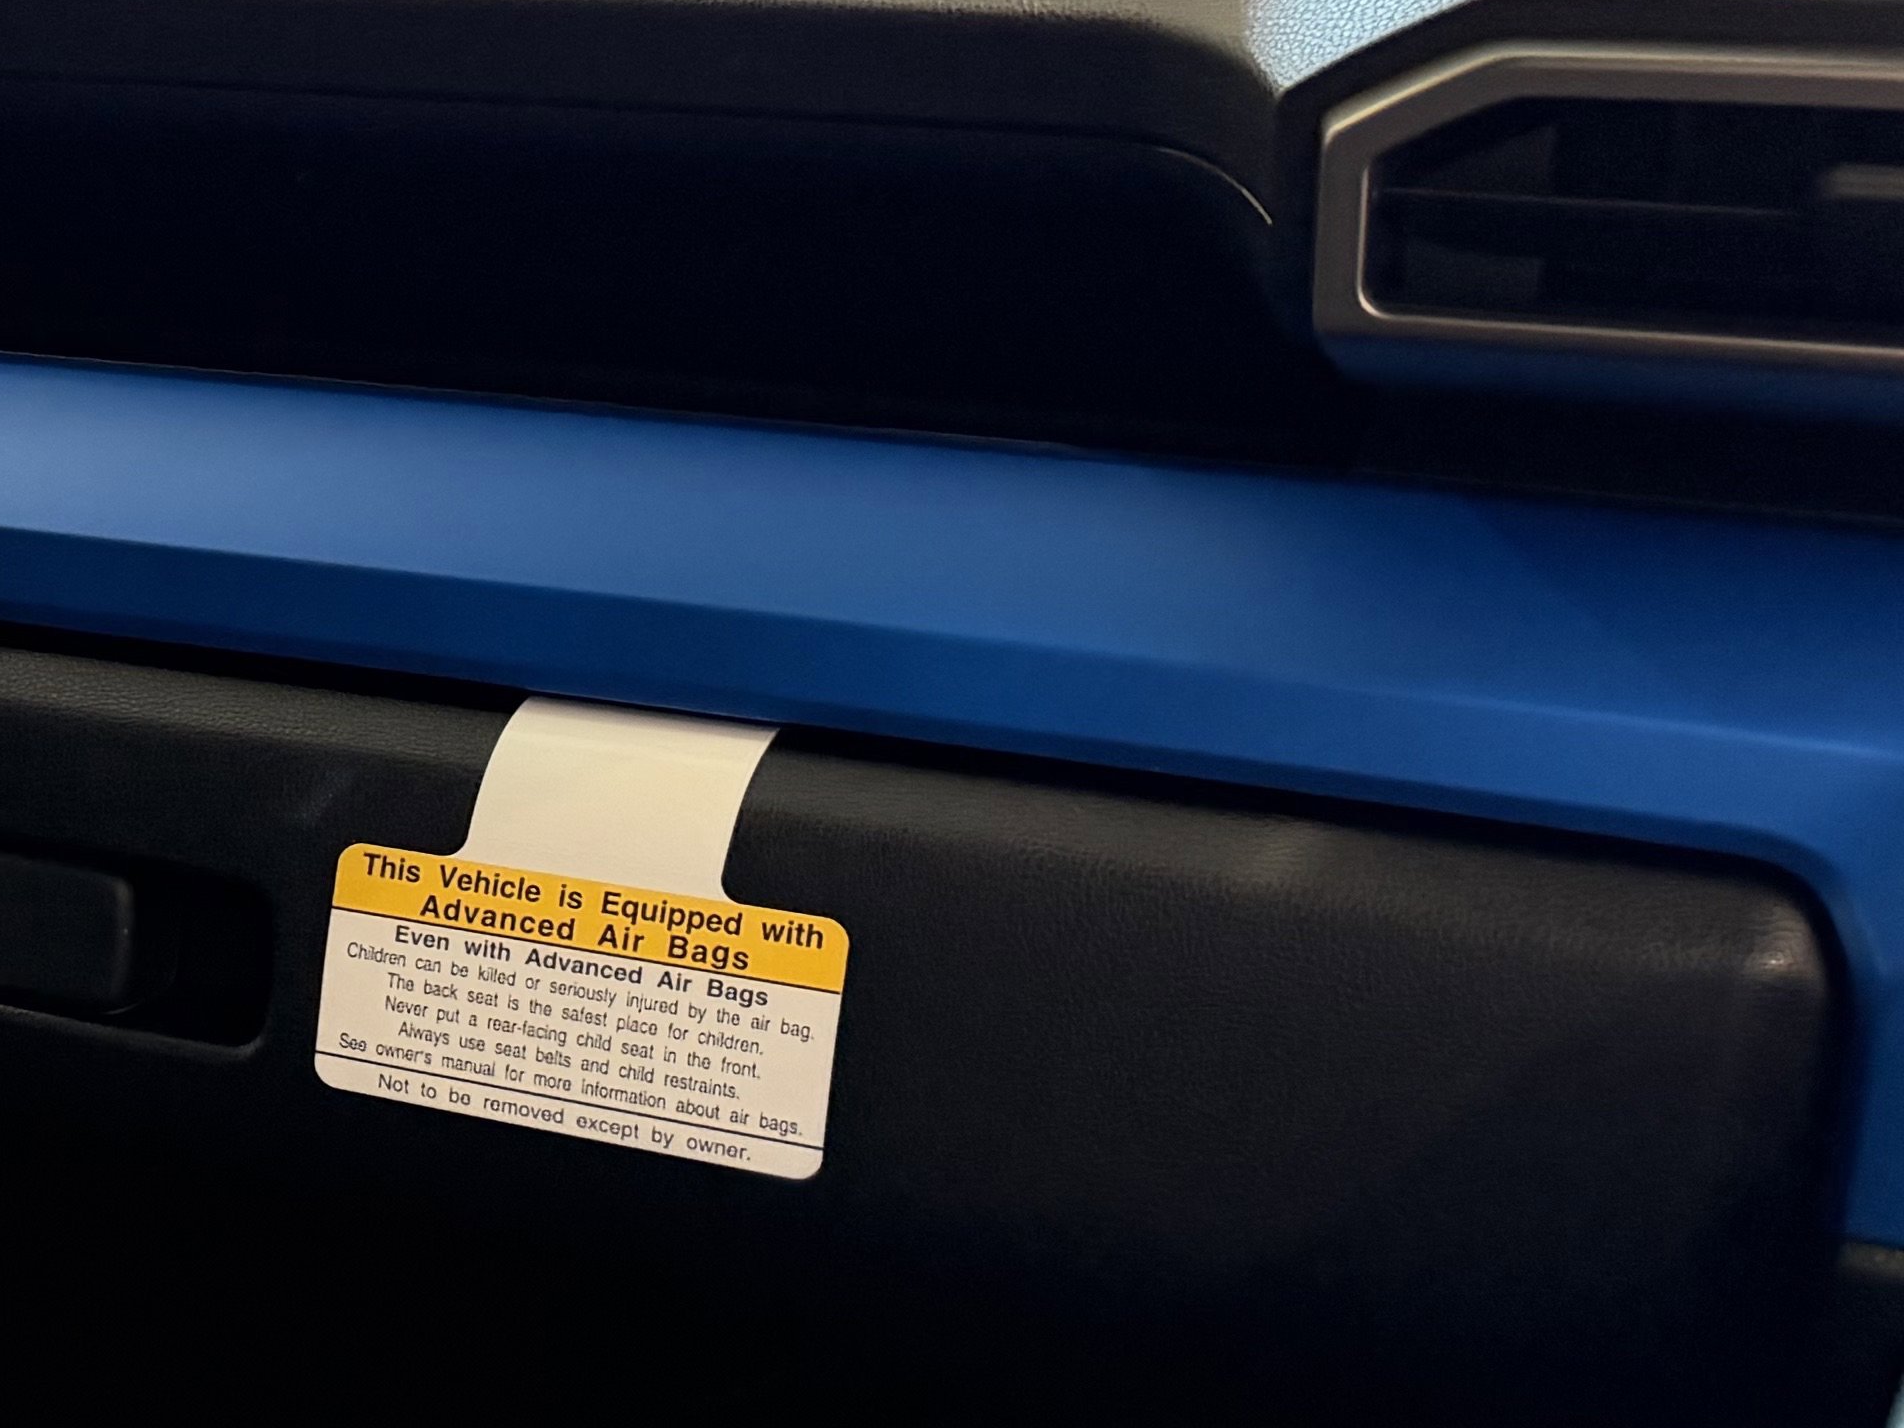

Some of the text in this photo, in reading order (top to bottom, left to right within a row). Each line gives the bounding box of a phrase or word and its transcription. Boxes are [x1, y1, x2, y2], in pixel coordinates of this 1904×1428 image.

[362, 851, 824, 950] This Vehicle is Equipped with
[419, 894, 750, 971] Advanced Air Bags
[346, 941, 814, 1042] Children can be killed or seriously injured by the air bag.
[394, 924, 769, 1009] Even with Advanced Air Bags
[384, 994, 761, 1079] Never put a rear-facing child seat in the front.
[387, 971, 763, 1056] The back seat is the safest place for children.
[338, 1032, 802, 1136] See owner's manual for more information about air bags.
[397, 1020, 740, 1100] Always use seat belts and child restraints.
[378, 1073, 751, 1161] Not to be removed except by owner.
